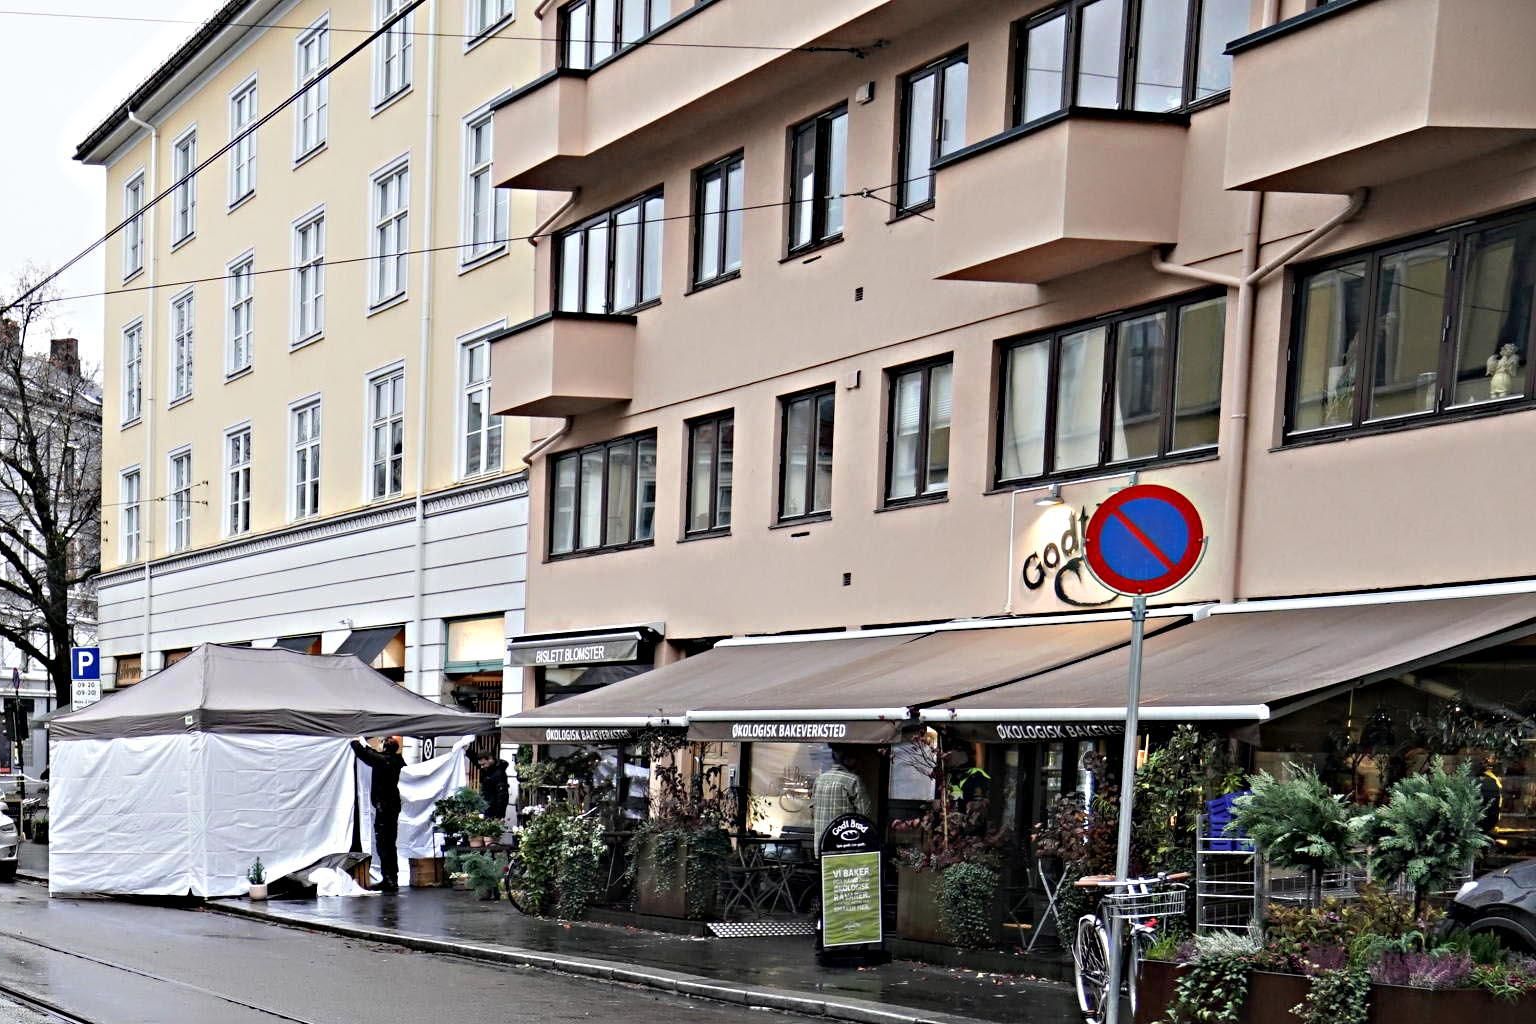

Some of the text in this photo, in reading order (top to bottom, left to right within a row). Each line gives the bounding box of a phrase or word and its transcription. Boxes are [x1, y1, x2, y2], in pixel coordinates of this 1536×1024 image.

[535, 645, 605, 664] BISLETT BLOMSTER
[78, 651, 94, 676] P
[545, 728, 581, 741] ØKOLOGISK
[732, 723, 846, 738] ØKOLOGISK BAKEVERKSTED
[996, 723, 1066, 740] ØKOLOGISK
